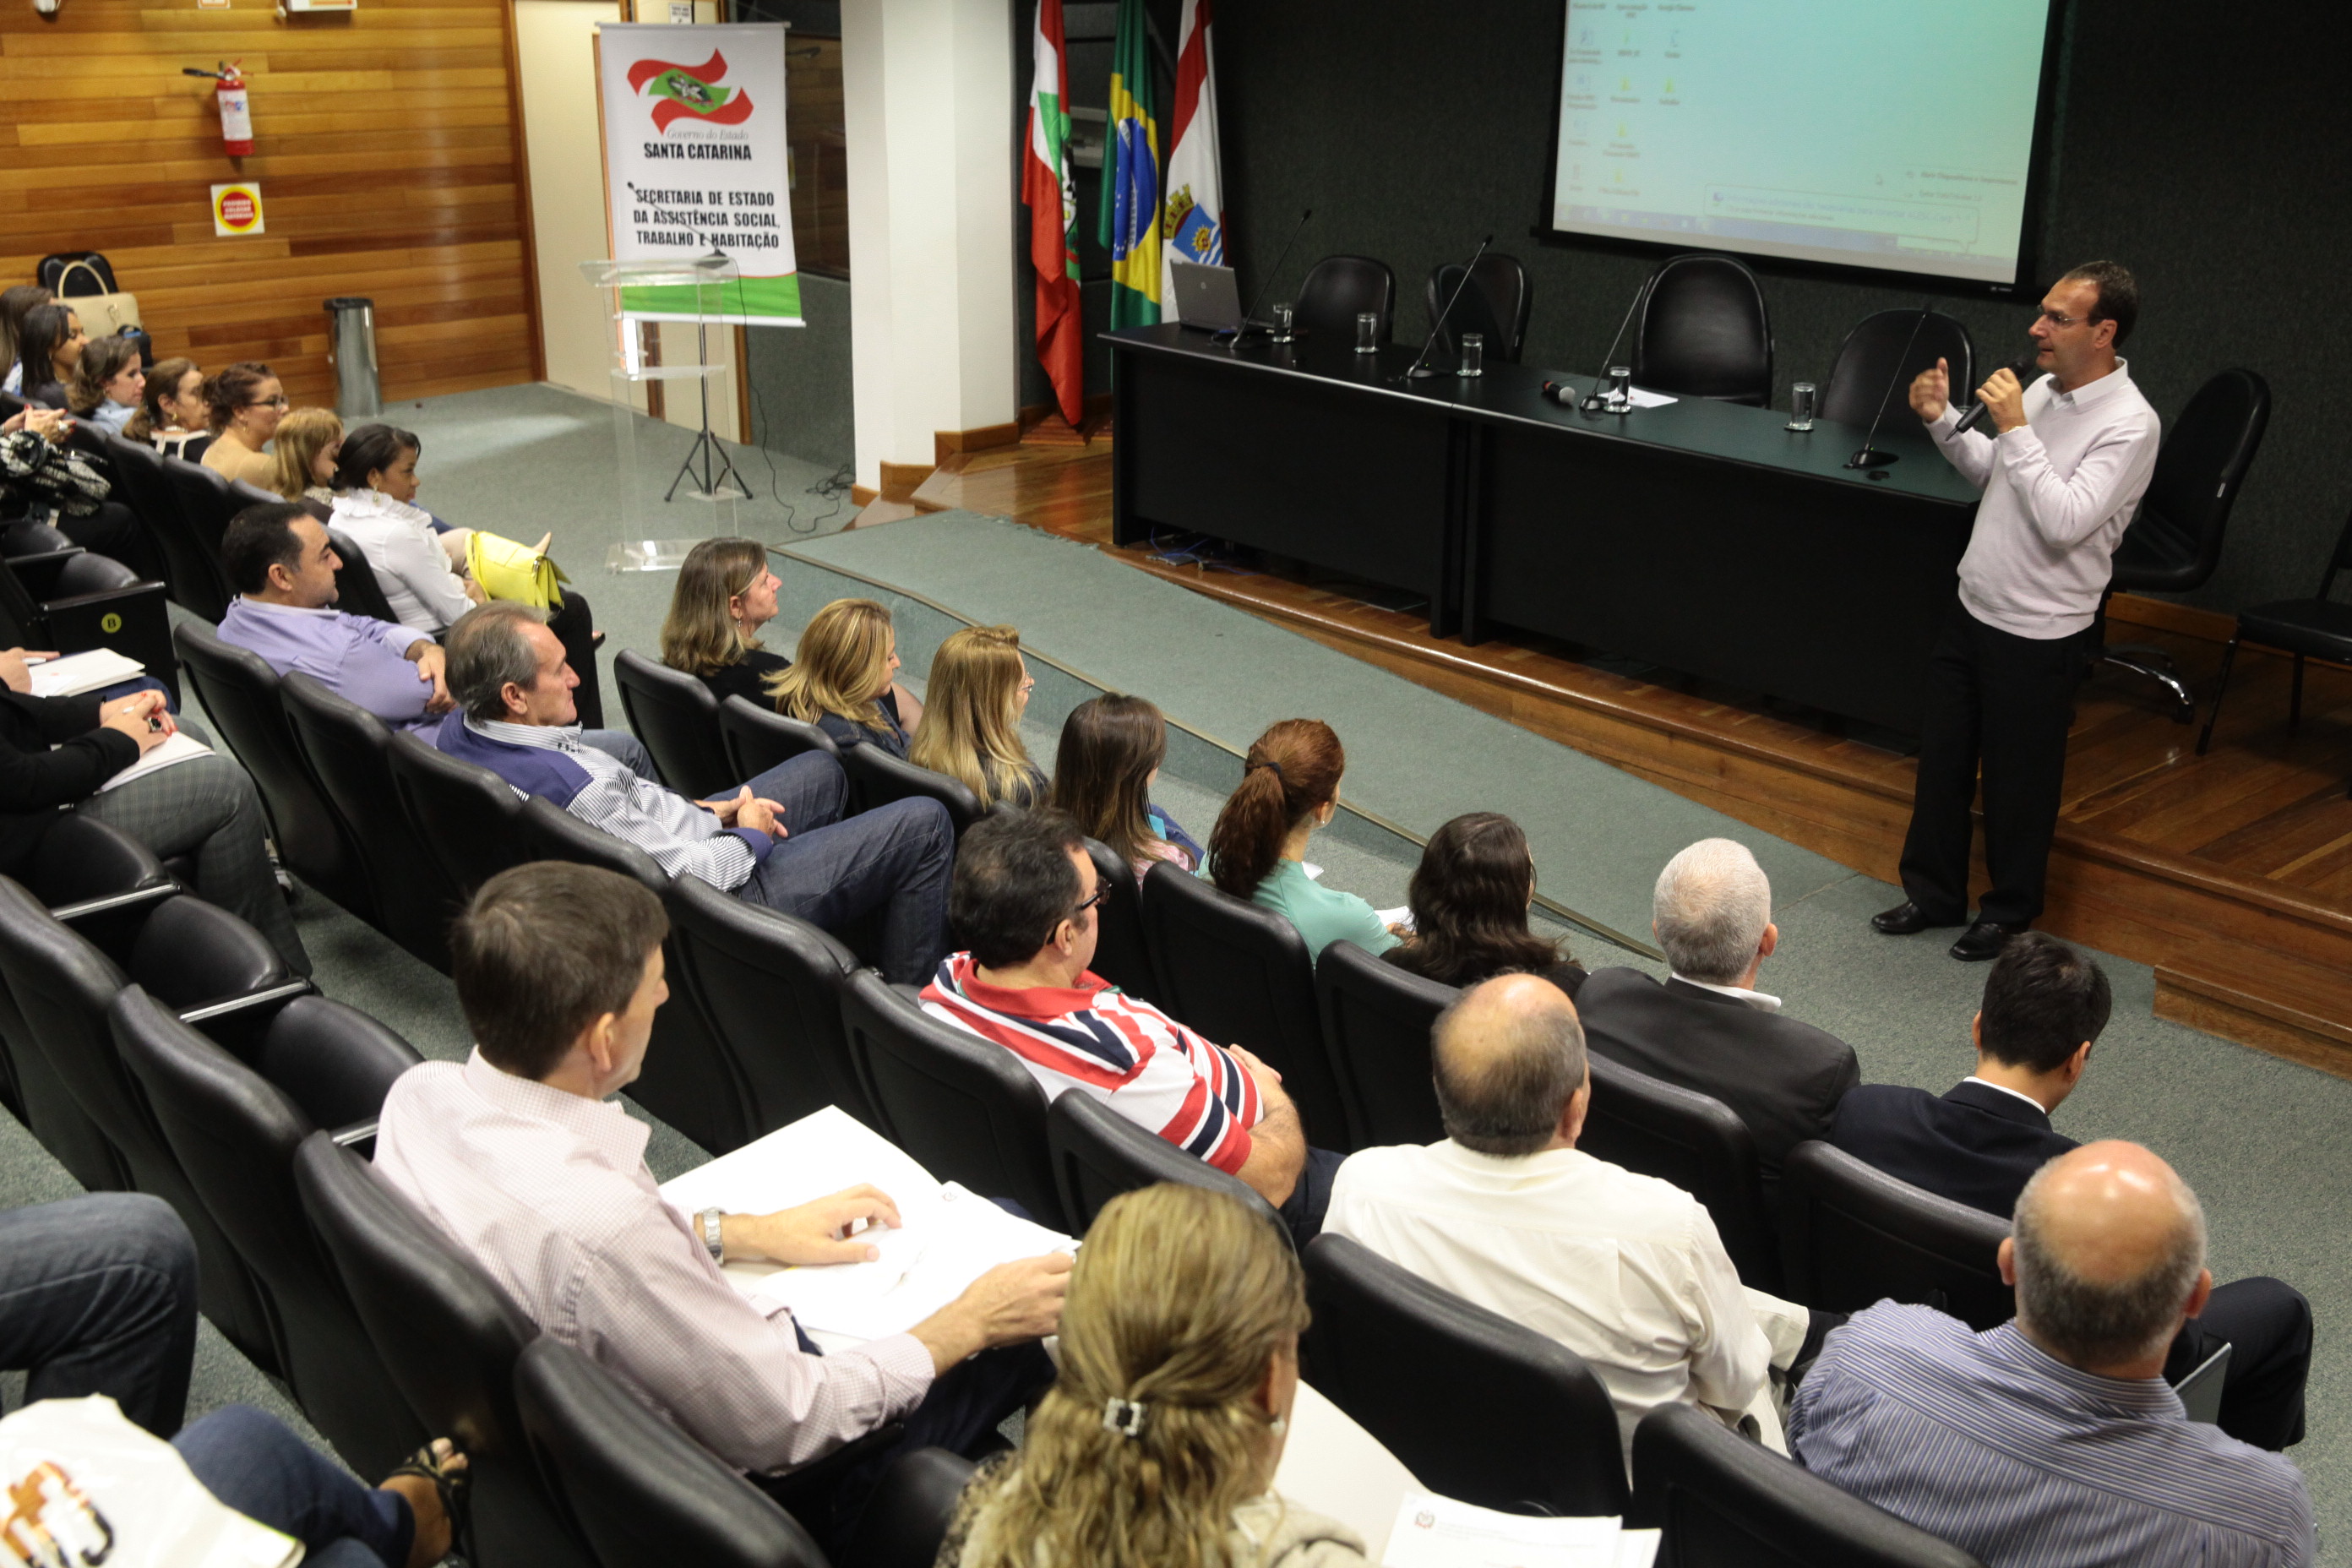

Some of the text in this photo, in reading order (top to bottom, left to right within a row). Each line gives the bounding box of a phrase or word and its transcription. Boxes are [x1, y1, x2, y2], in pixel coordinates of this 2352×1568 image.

[667, 128, 749, 140] Governo do Estado
[644, 143, 752, 161] SANTA CATARINA
[635, 189, 775, 206] SECRETARIA DE ESTADO
[634, 210, 780, 229] DA ASSISTÊNCIA SOCIAL,
[637, 231, 779, 250] TRABALHO E HABITAÇÃO
[107, 618, 117, 629] B
